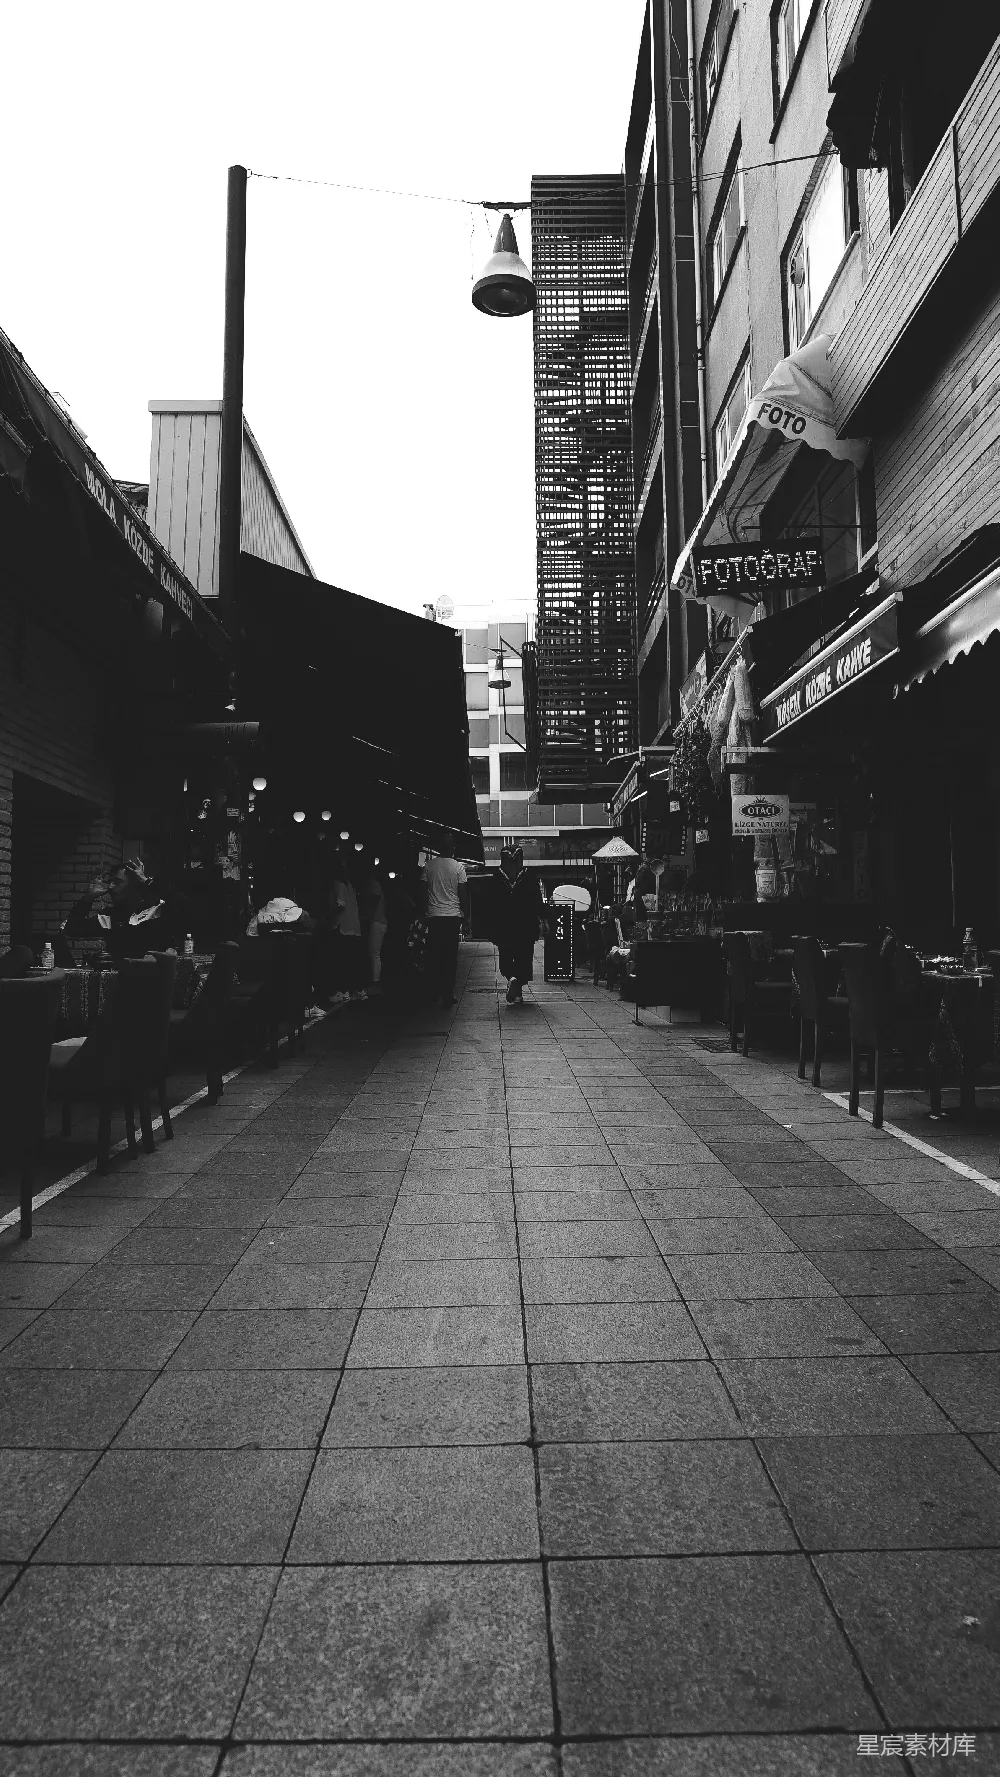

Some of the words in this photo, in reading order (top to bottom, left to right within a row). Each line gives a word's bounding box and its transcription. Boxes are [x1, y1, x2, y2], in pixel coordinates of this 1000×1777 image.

[756, 403, 807, 435] FOTO
[123, 514, 154, 574] KÖZDE
[698, 549, 817, 586] FOTOĞRAF
[836, 636, 872, 686] KAHVE
